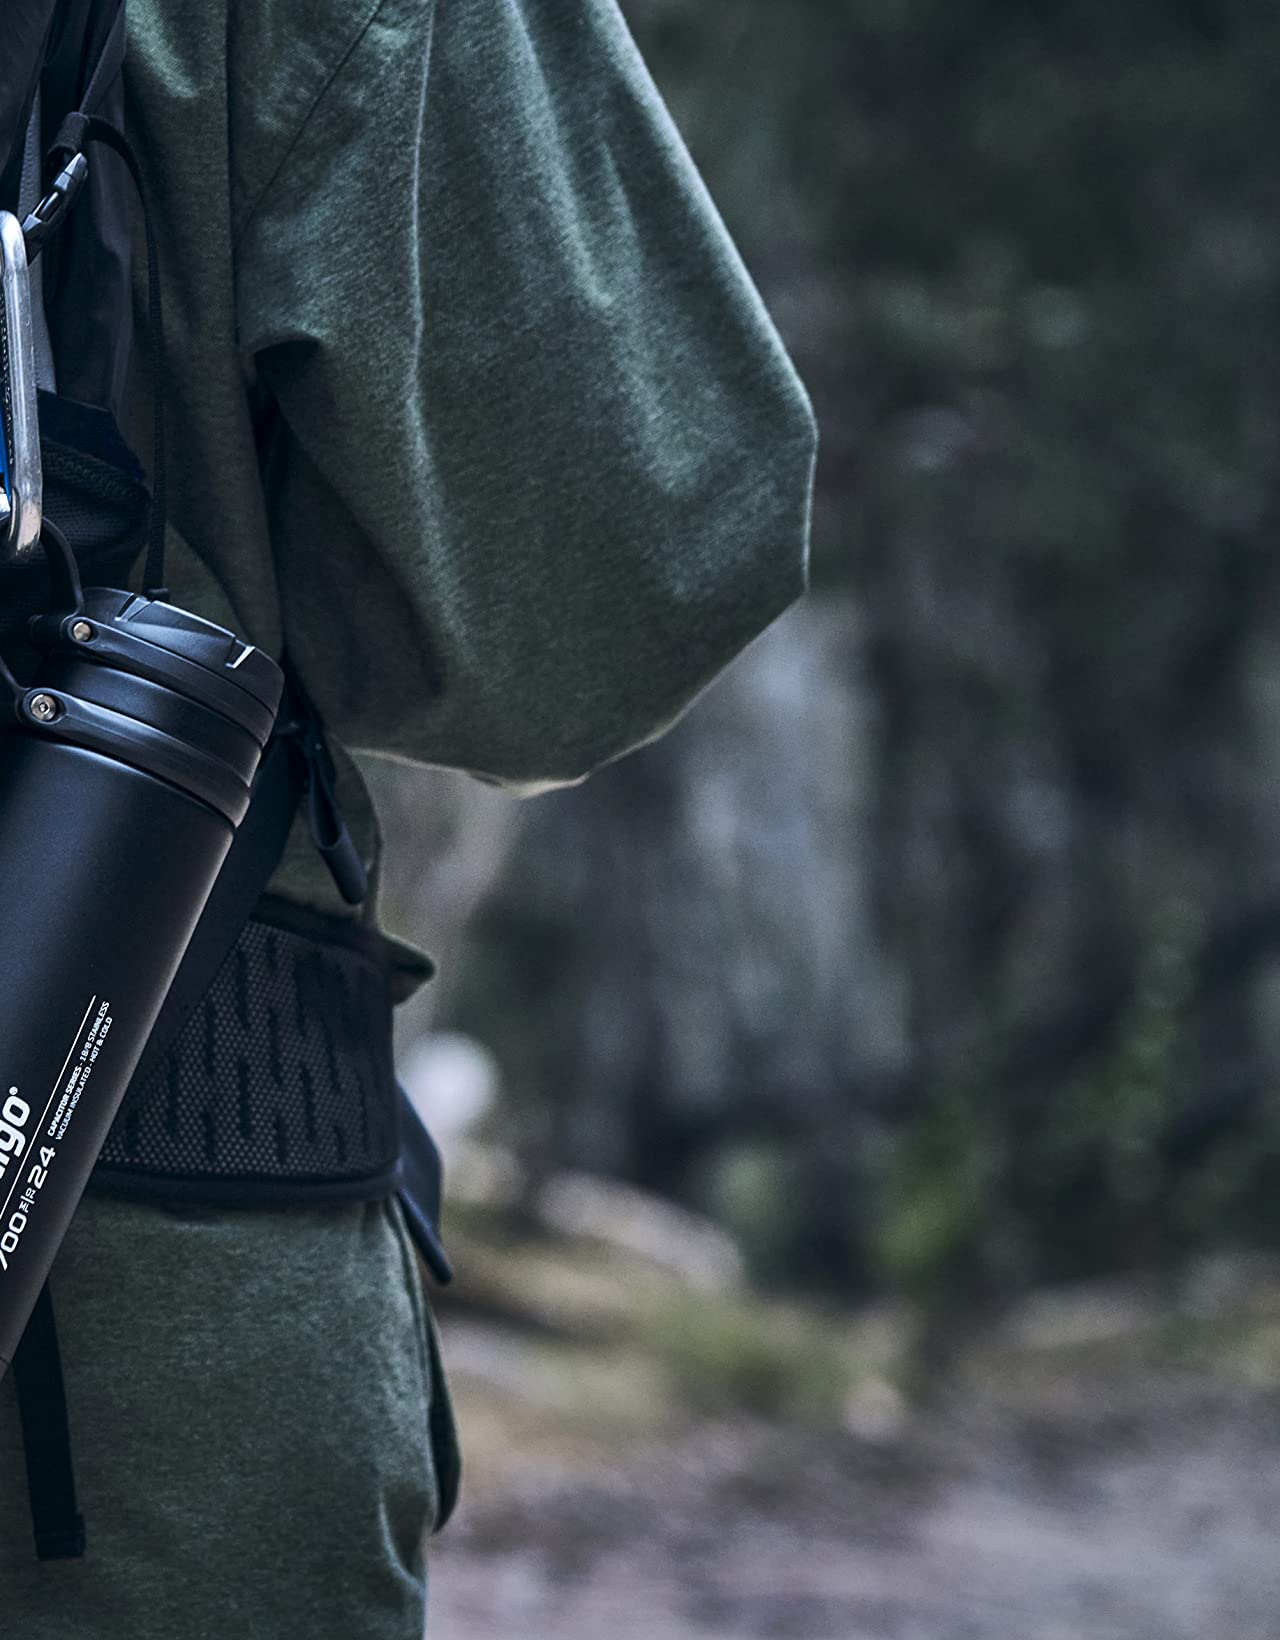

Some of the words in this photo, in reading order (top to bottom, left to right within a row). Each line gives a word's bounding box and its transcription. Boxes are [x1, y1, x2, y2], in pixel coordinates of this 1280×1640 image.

[47, 1093, 70, 1136] CAPACITOR
[65, 1065, 82, 1094] SERIES
[80, 1041, 92, 1062] 18/8
[87, 1001, 110, 1042] STAINLESS
[55, 1108, 73, 1140] VACUUM
[69, 1066, 92, 1109] INSULATED
[89, 1045, 100, 1063] HOT
[99, 1016, 113, 1039] COLD
[27, 1145, 56, 1189] 24
[18, 1200, 30, 1213] ML
[25, 1187, 36, 1199] OZ
